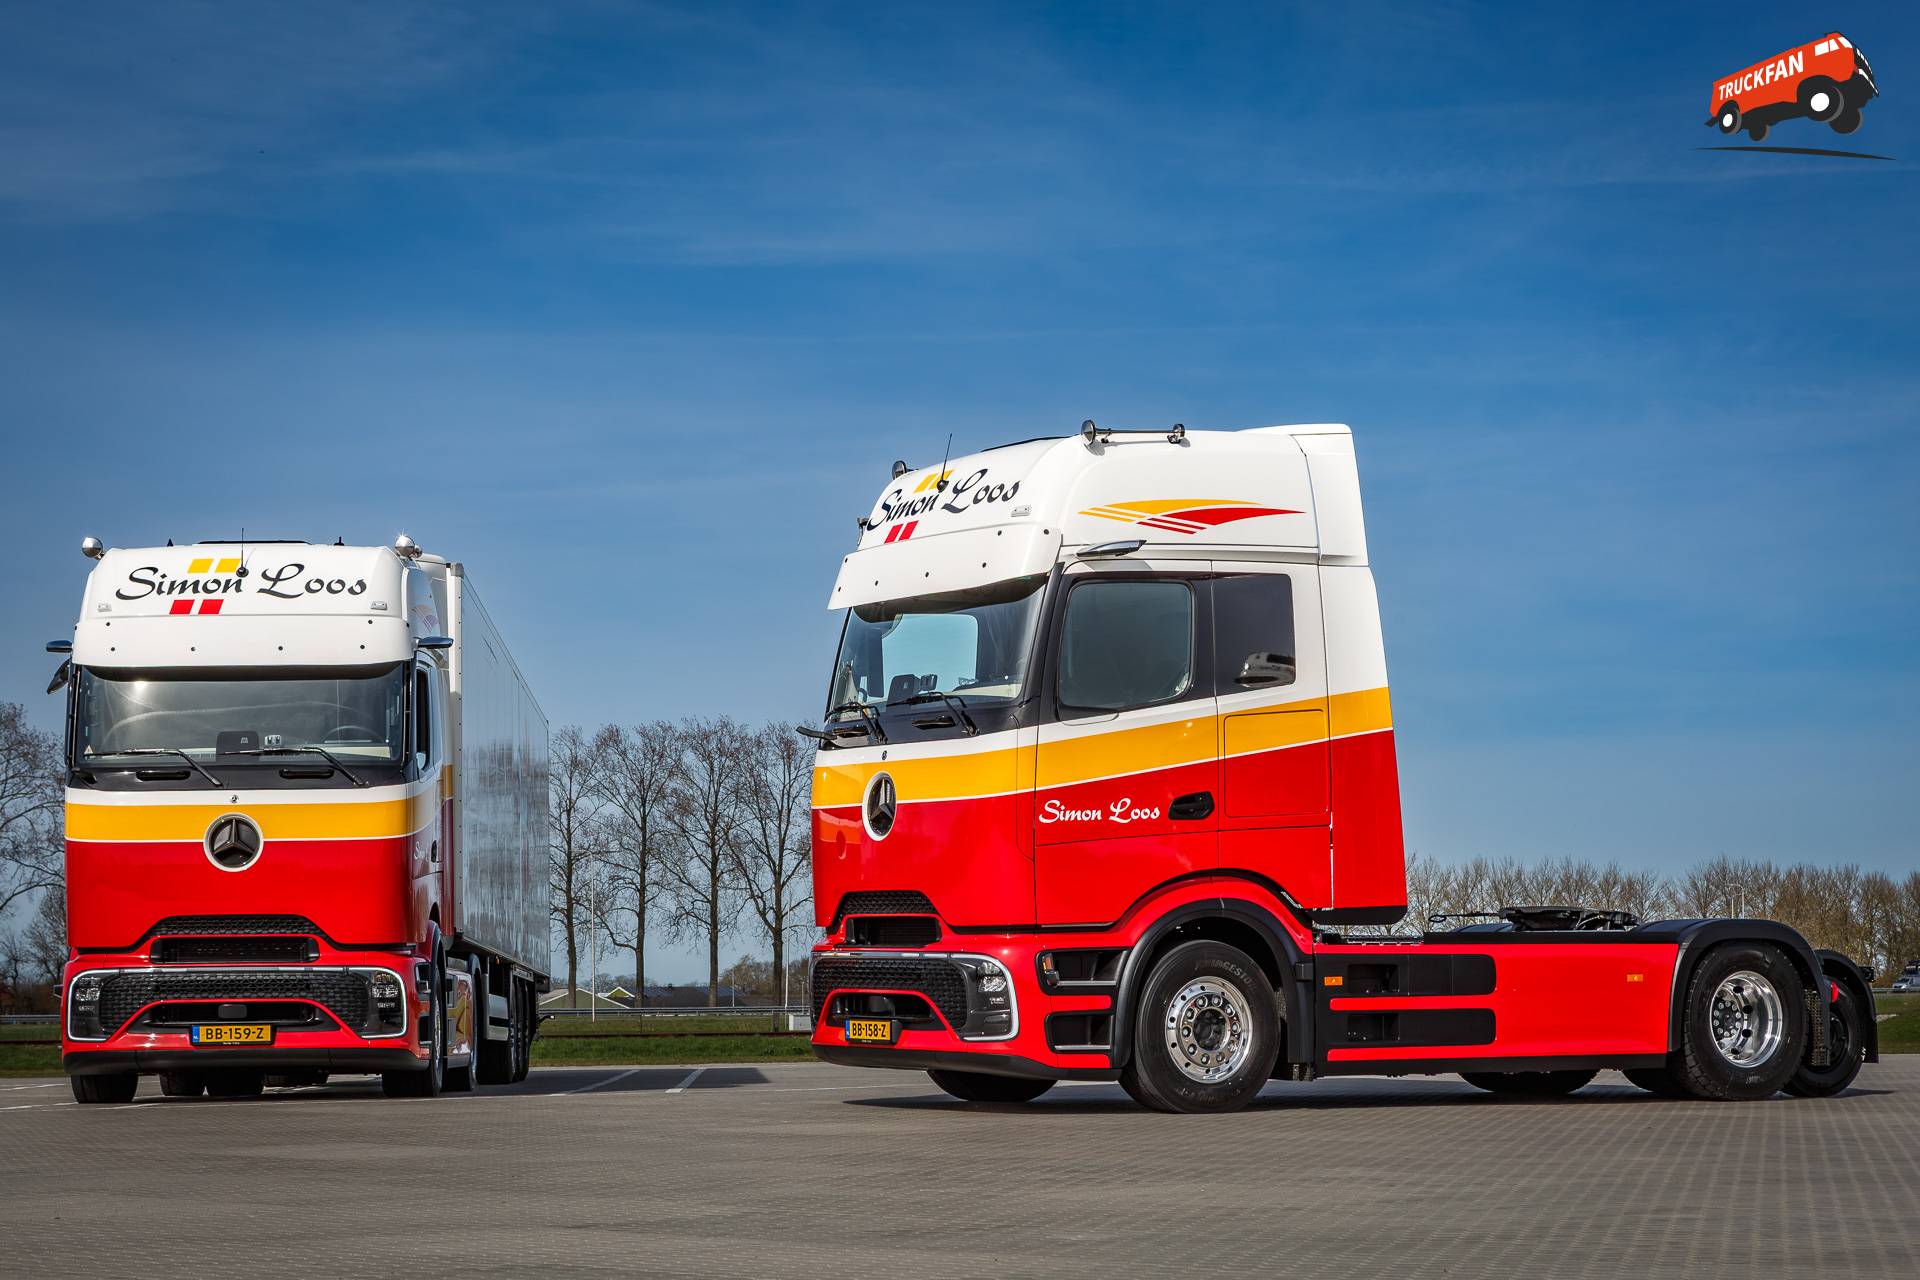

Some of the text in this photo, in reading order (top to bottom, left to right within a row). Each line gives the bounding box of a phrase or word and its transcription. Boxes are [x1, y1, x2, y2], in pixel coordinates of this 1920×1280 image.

[866, 468, 1021, 531] Simon Loos
[115, 563, 367, 600] Simon Loos
[1038, 797, 1160, 824] Simon Loos
[205, 1027, 264, 1040] BB-159-Z
[852, 1022, 886, 1038] BB-158-Z
